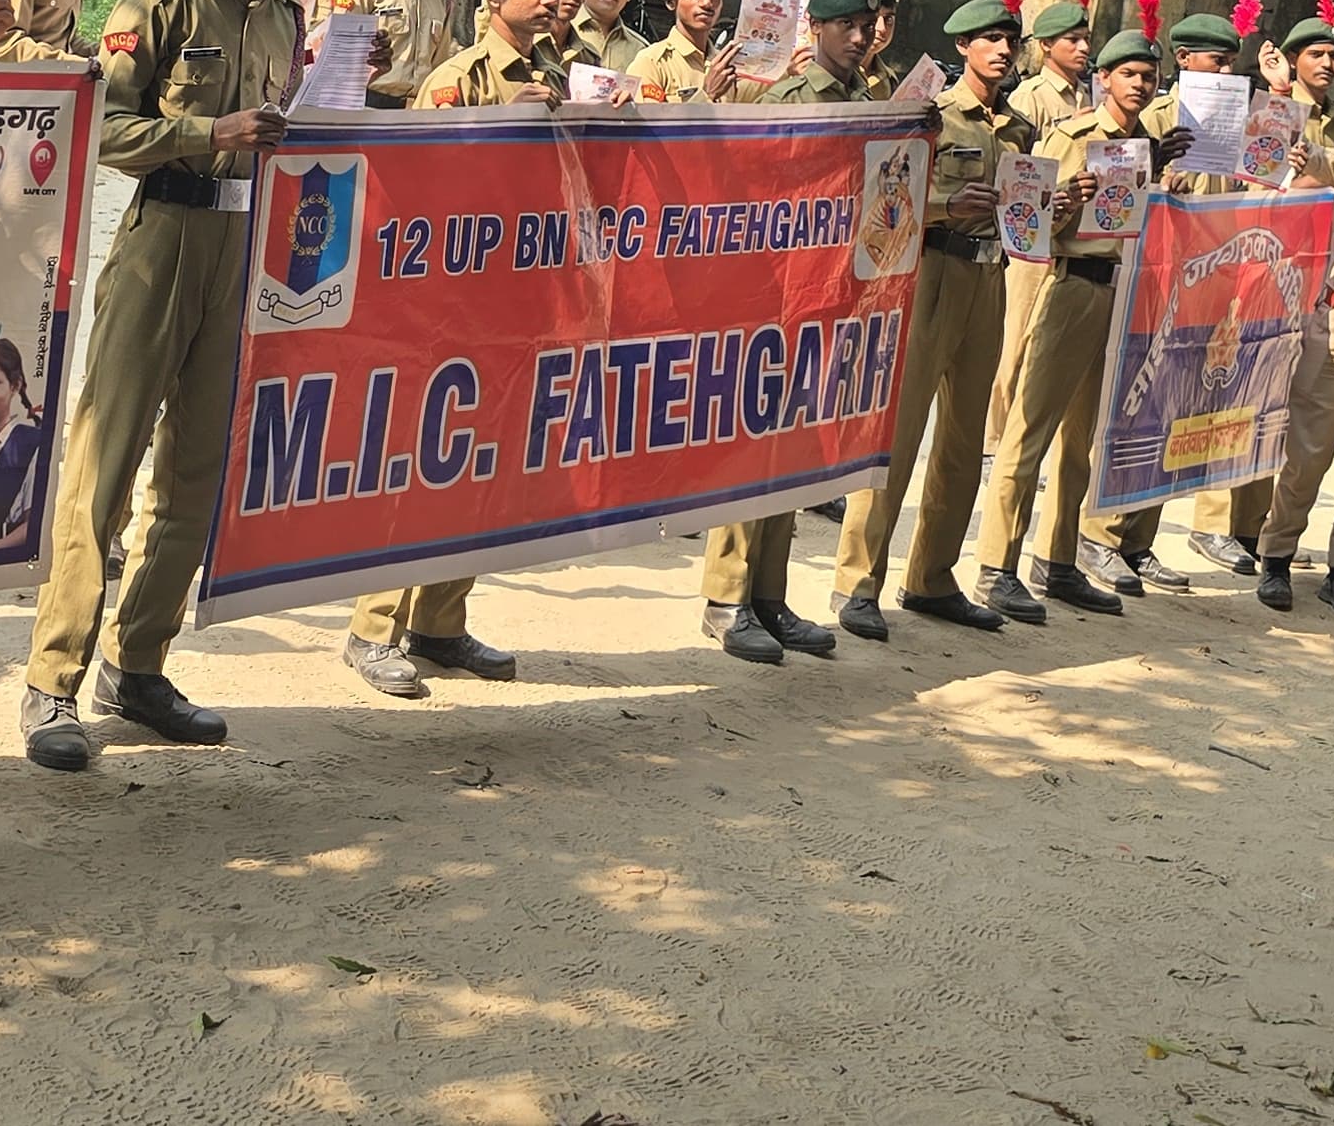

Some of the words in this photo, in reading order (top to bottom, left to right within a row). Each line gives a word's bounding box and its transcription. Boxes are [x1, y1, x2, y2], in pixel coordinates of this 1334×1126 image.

[110, 34, 135, 47] NCC
[23, 188, 40, 196] SAFE
[41, 188, 57, 196] CITY
[297, 215, 328, 235] NCC
[377, 217, 433, 280] 12
[443, 213, 505, 275] UP
[513, 210, 570, 271] BN
[655, 195, 856, 260] FATEHGARH
[38, 300, 52, 333] कपिल
[240, 357, 498, 516] M.I.C.
[523, 308, 903, 474] FATEHGARH
